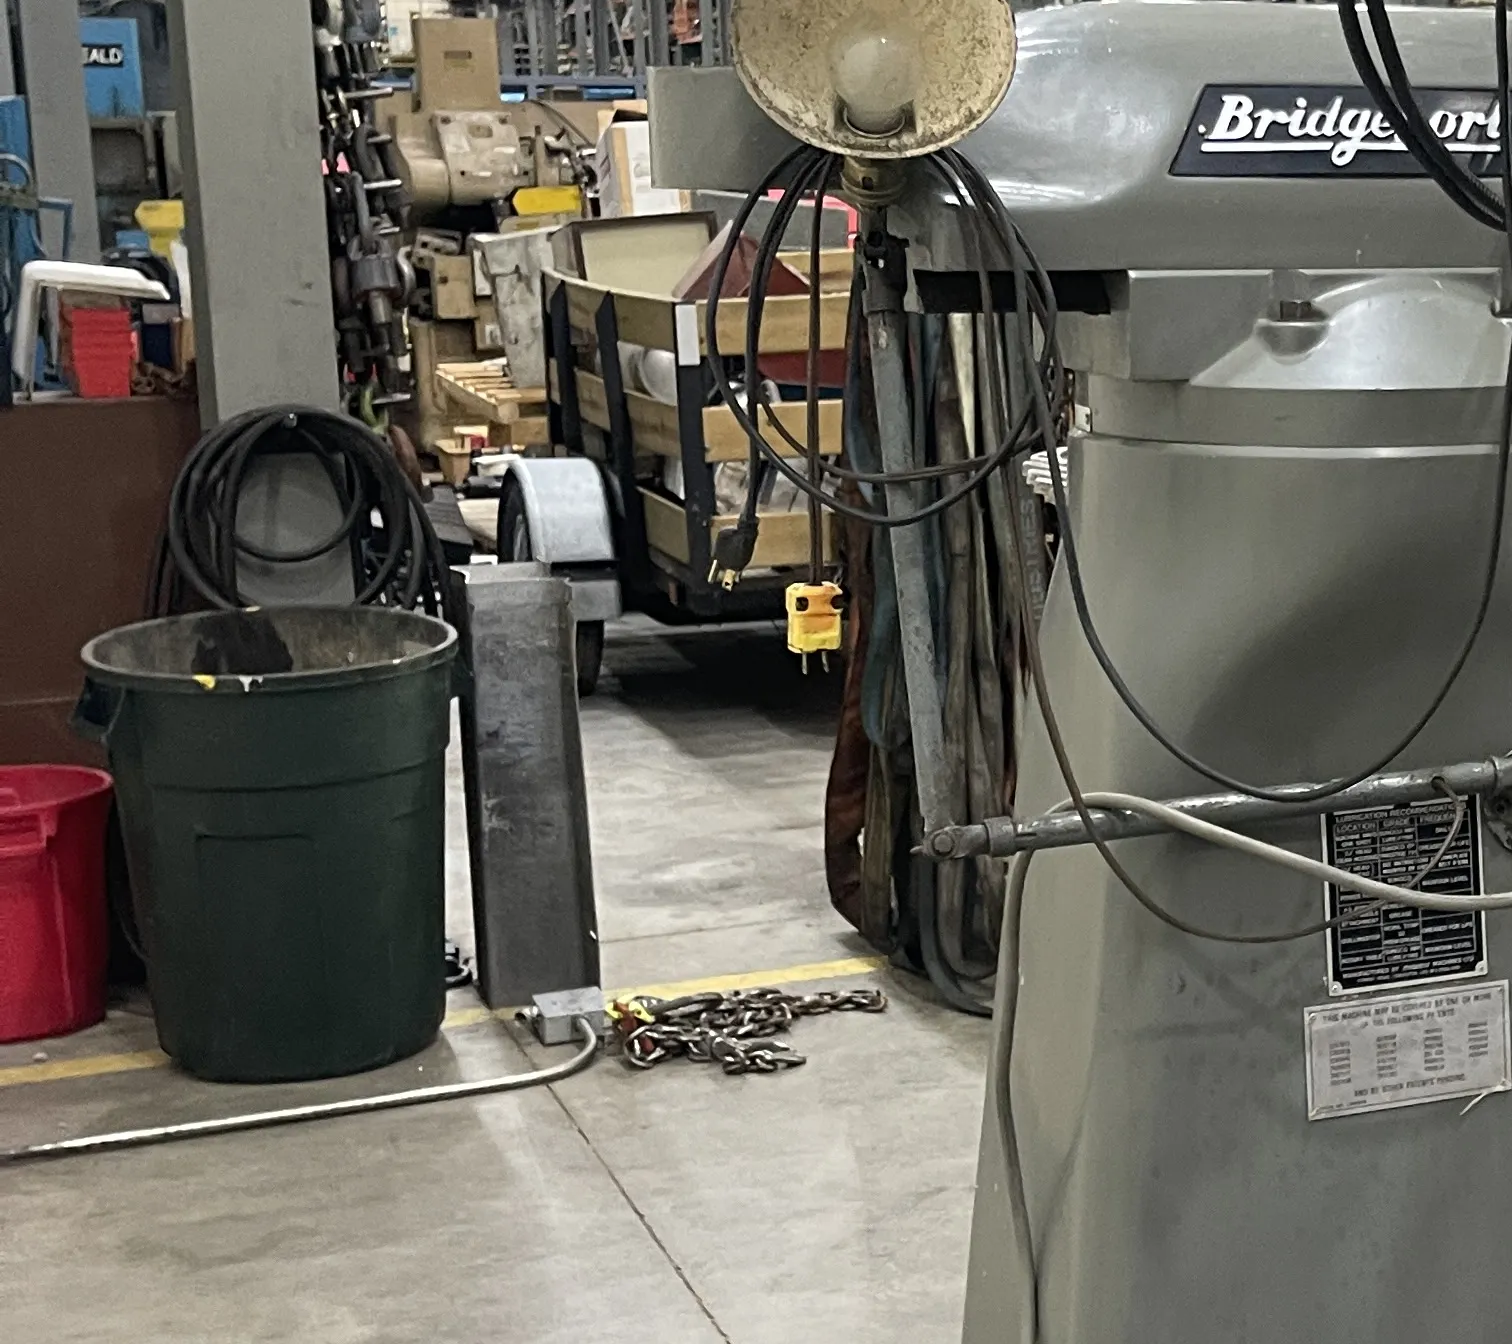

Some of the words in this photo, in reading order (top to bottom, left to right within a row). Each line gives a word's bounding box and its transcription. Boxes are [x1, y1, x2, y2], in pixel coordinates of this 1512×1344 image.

[1203, 94, 1502, 166] Bridgeort
[1336, 822, 1376, 834] LOCATION
[1426, 1007, 1456, 1020] PAENTS
